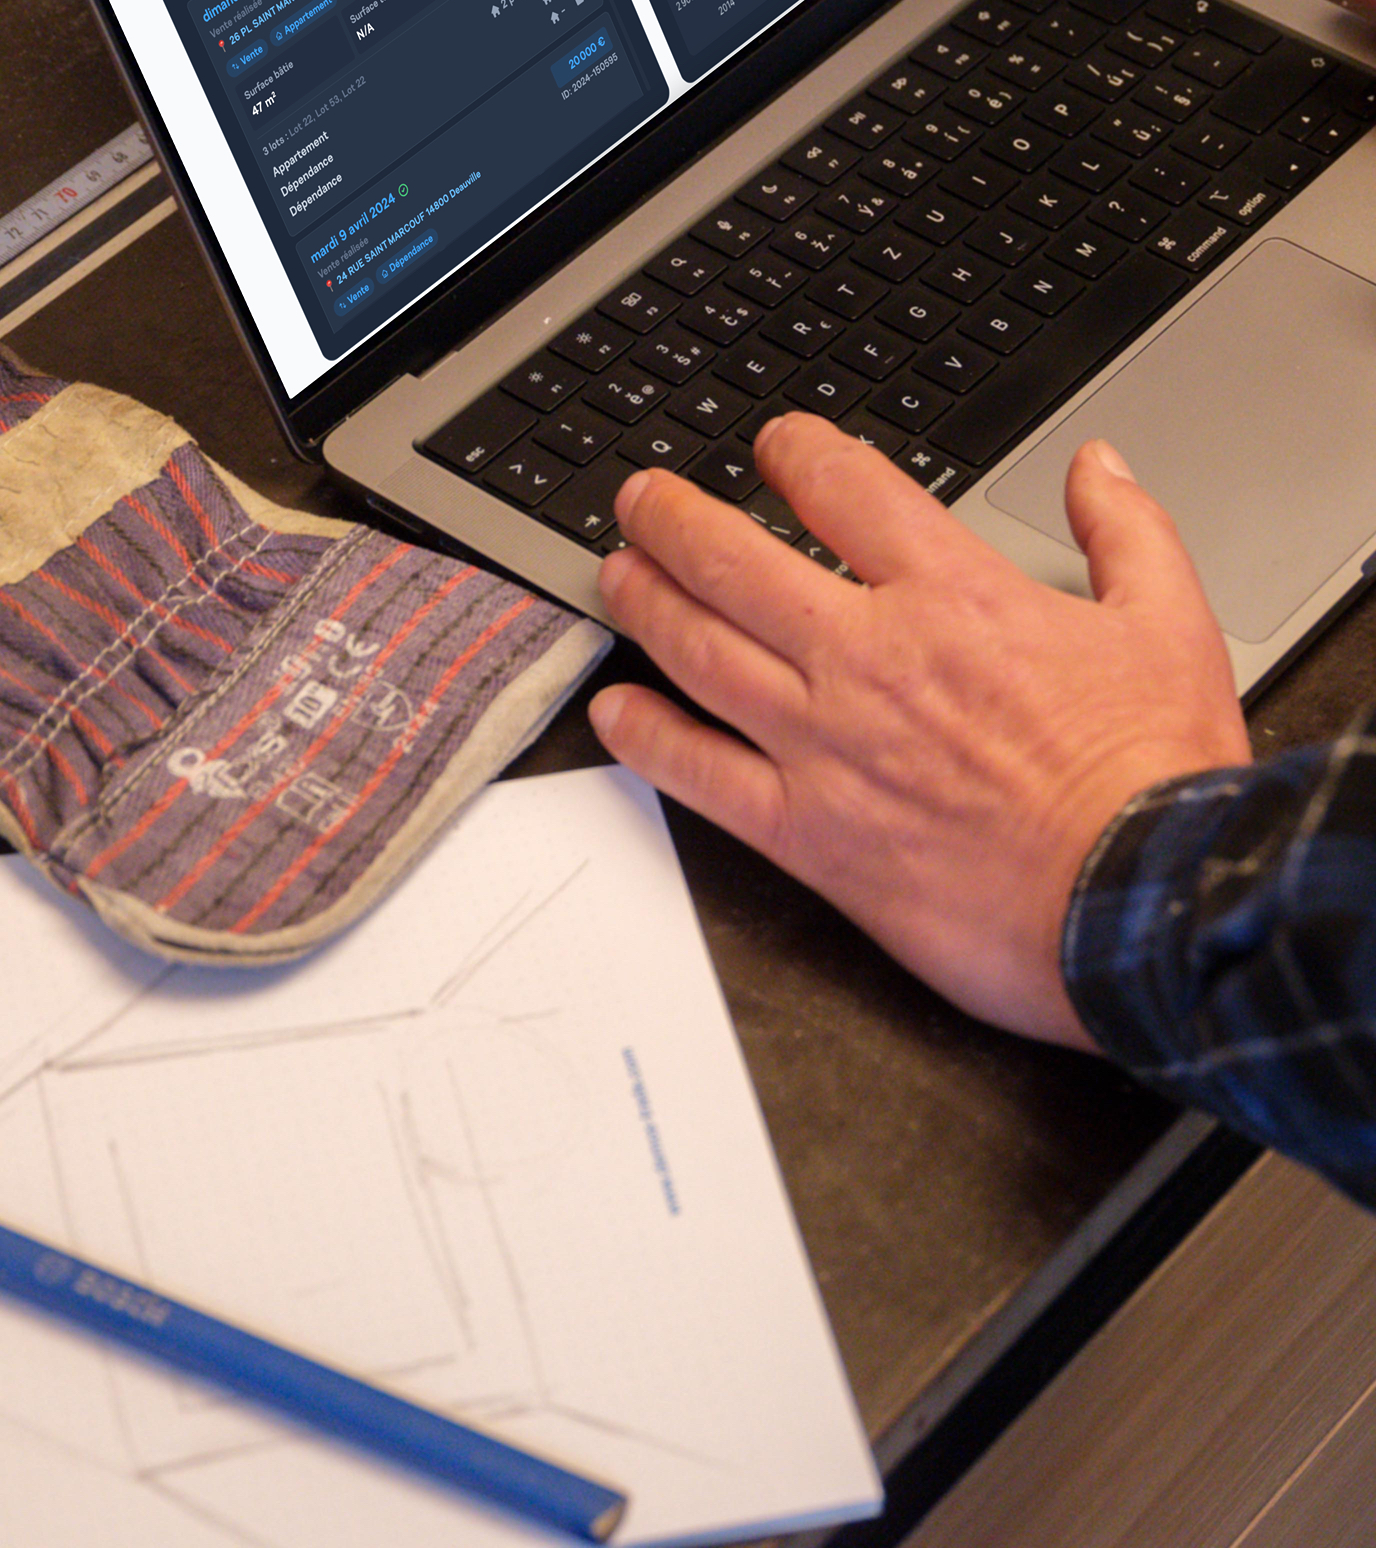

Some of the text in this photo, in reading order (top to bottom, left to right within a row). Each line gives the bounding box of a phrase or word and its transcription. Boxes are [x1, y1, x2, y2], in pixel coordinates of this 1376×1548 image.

[349, 0, 379, 24] Surface
[208, 19, 234, 38] Vente
[228, 31, 241, 45] 26
[239, 24, 253, 37] PL
[251, 5, 276, 29] SAINT
[355, 22, 376, 41] N/A
[239, 46, 264, 65] Vente
[243, 61, 294, 100] Surface bâtie
[560, 52, 619, 101] ID: 2024-150595
[252, 100, 263, 116] 47
[262, 75, 367, 156] 3 lots Lot 22, Lot 53, Lot 22
[1054, 104, 1068, 115] P
[272, 131, 330, 178] Appartement
[1082, 162, 1099, 170] L
[279, 154, 334, 198] Dépendance
[288, 174, 343, 217] Dépendance
[1039, 195, 1057, 207] K
[4, 226, 23, 240] 72
[31, 208, 49, 221] 71
[53, 186, 78, 204] 70
[85, 170, 102, 183] 69
[1239, 193, 1265, 216] option
[927, 210, 944, 222] U
[310, 192, 396, 264] mardi 9 avril 2024
[336, 171, 482, 285] 24 RUE SAINT MARCOUF 14800 Deauville
[1000, 232, 1013, 243] J
[883, 247, 901, 259] Z
[1076, 243, 1096, 257] M
[1187, 227, 1230, 264] command
[316, 237, 370, 279] Vente réalisée
[388, 235, 434, 273] Dépendance
[952, 268, 971, 281] H
[346, 284, 370, 304] Vente
[838, 284, 854, 295] T
[1034, 280, 1052, 293] N
[910, 306, 926, 318] G
[793, 323, 811, 334] R
[990, 319, 1008, 331] B
[864, 344, 877, 356] F
[747, 361, 765, 373] E
[945, 356, 962, 368] V
[817, 384, 835, 396] D
[697, 398, 718, 413] W
[902, 396, 919, 408] C
[466, 447, 484, 462] esc
[652, 441, 672, 453] Q
[726, 465, 743, 477] A
